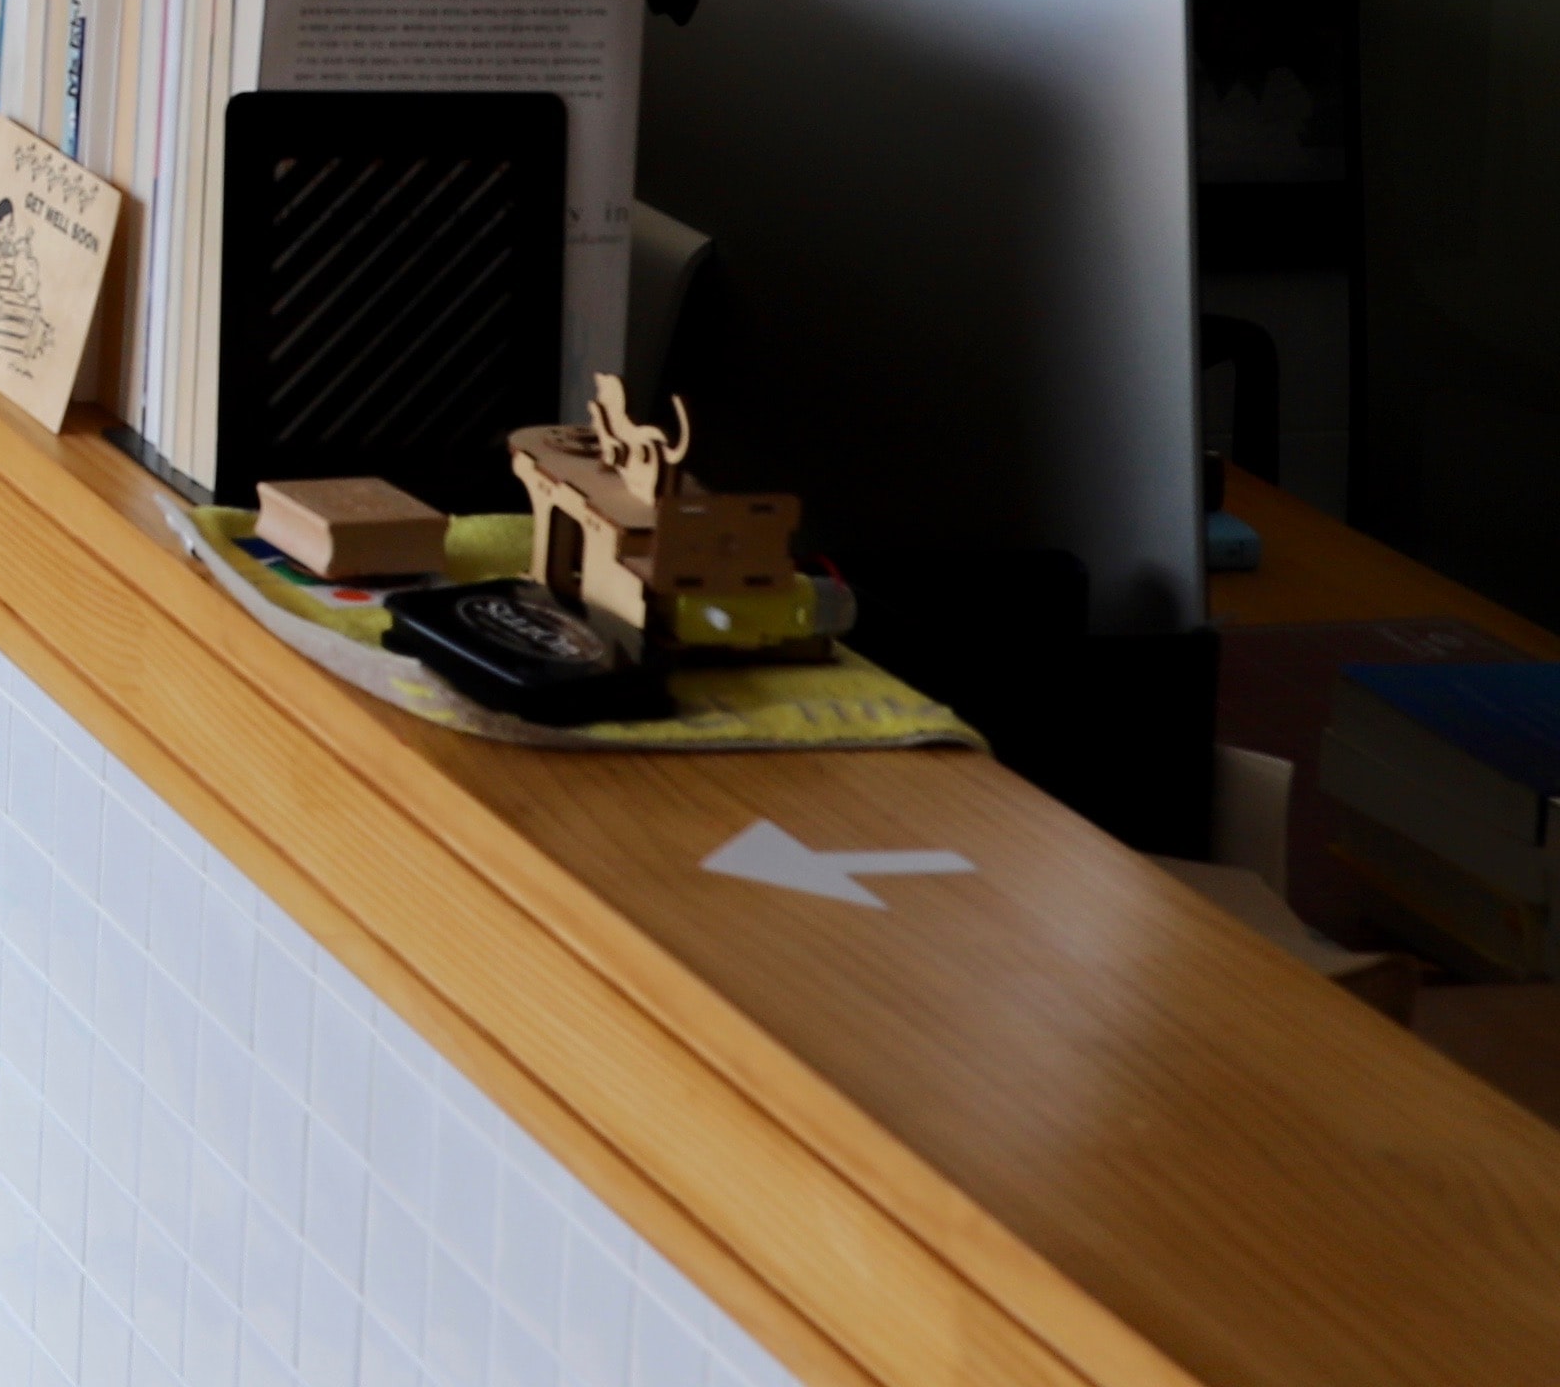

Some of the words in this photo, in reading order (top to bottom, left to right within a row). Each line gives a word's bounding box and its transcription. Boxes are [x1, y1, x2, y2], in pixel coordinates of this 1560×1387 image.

[25, 191, 43, 217] GET
[45, 204, 69, 235] WELL
[71, 220, 100, 254] SOON
